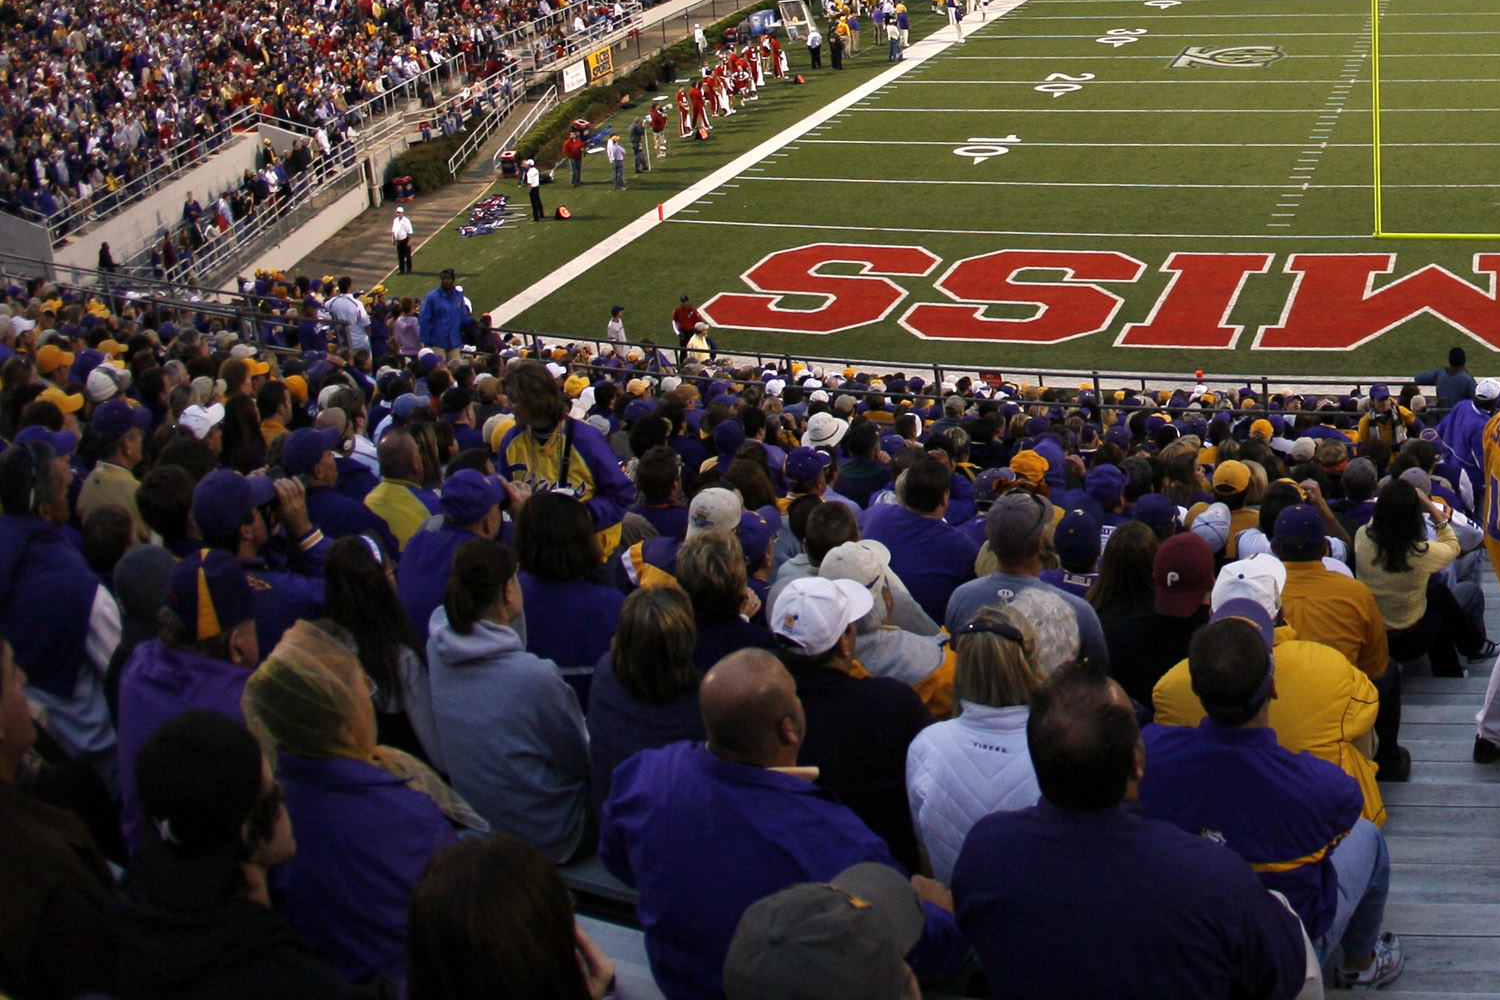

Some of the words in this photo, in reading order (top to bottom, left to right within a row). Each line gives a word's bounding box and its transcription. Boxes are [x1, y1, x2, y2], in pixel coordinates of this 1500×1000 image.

[1096, 28, 1148, 48] 30
[1034, 73, 1096, 99] 20
[953, 134, 1022, 165] 10
[1167, 571, 1179, 586] P
